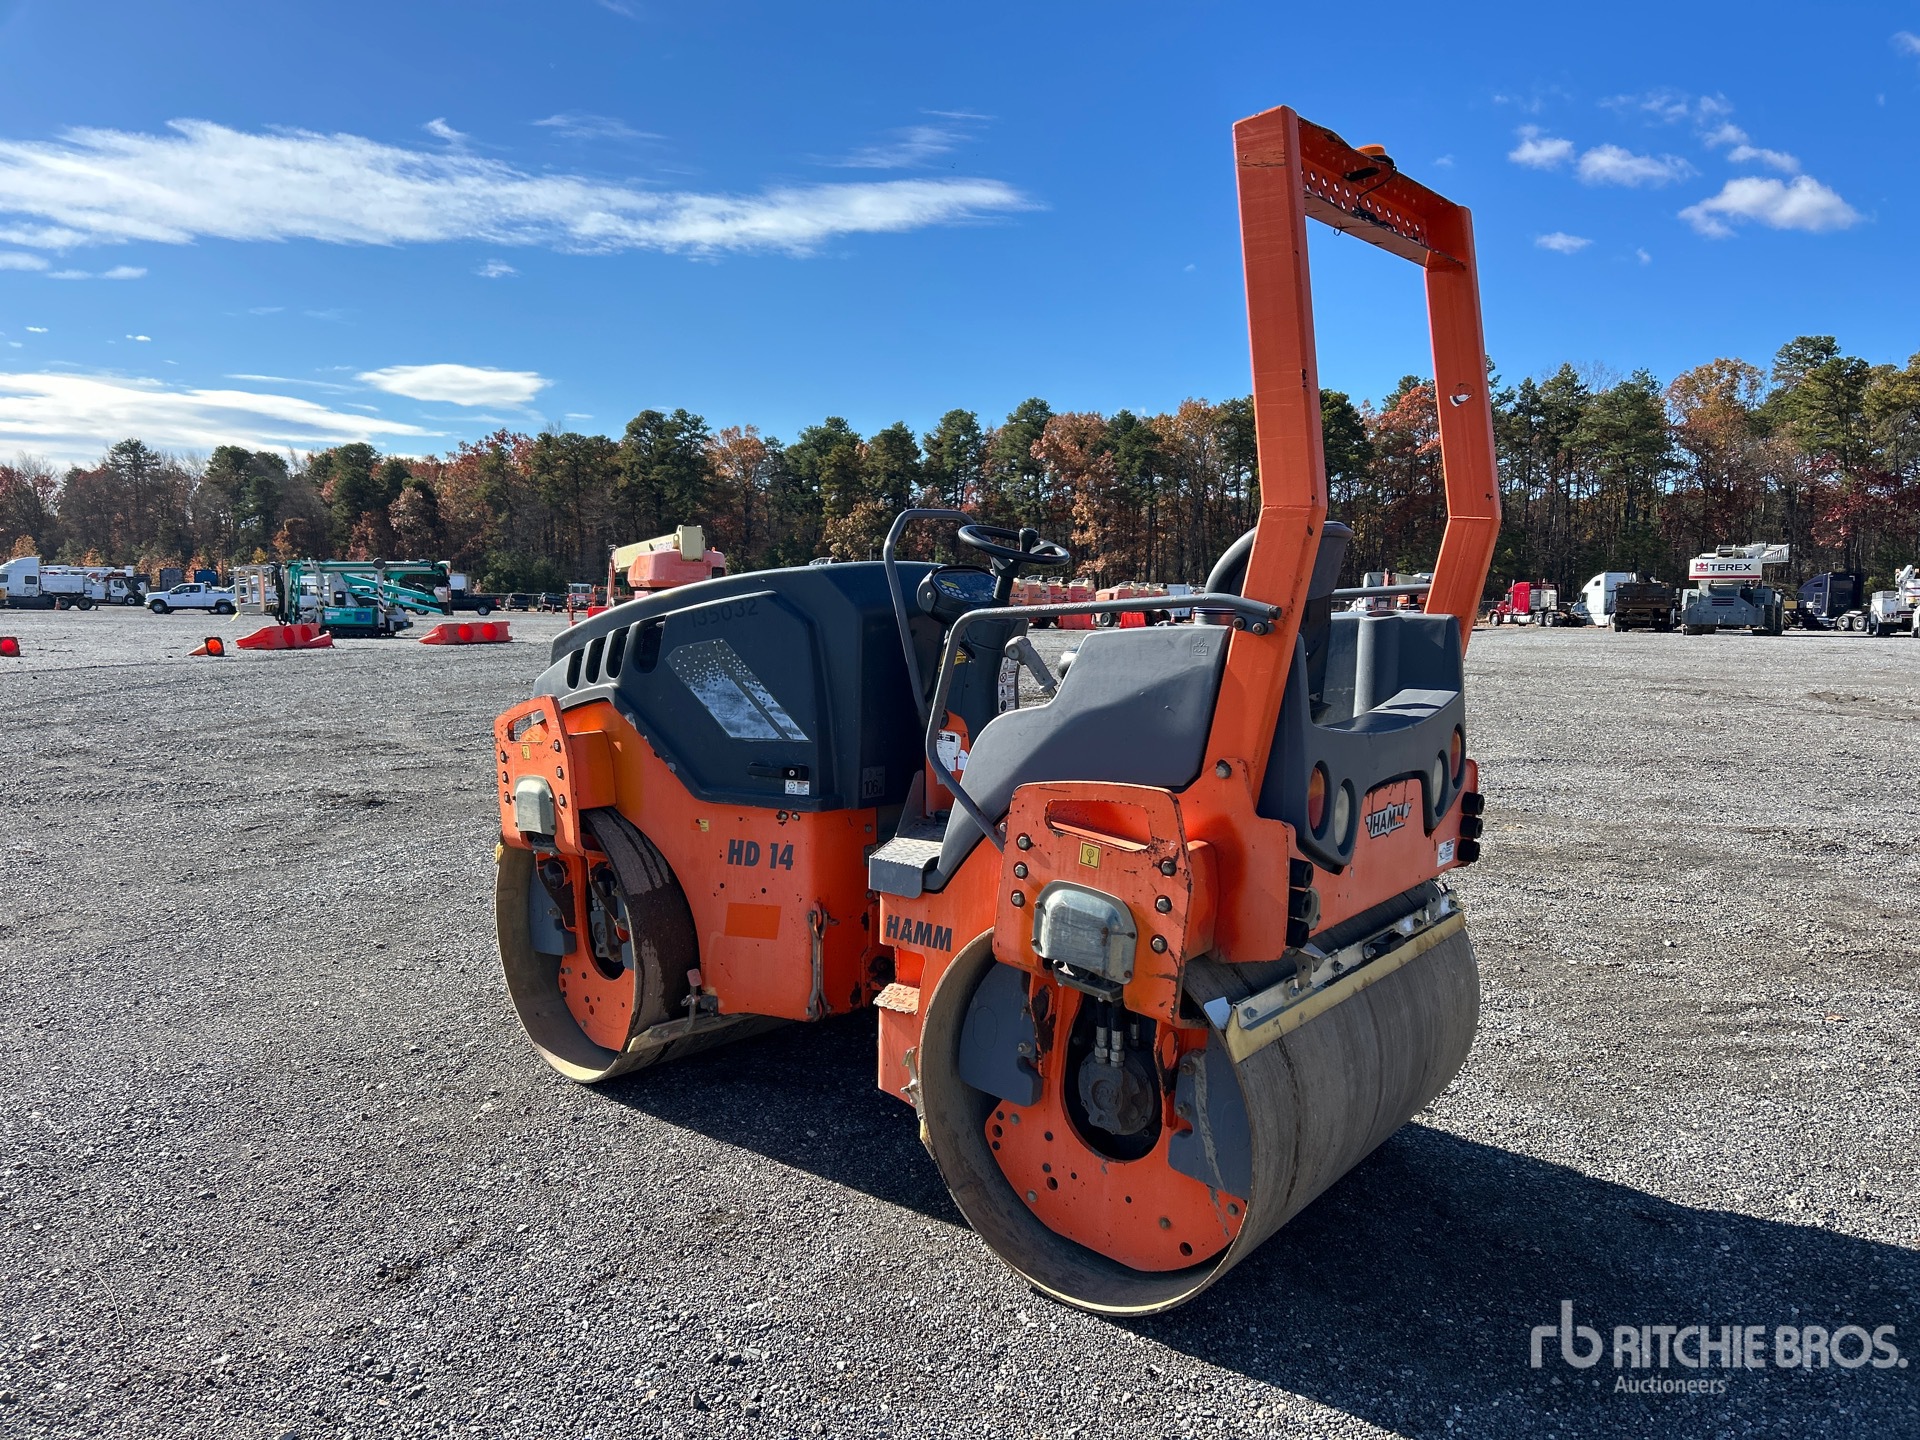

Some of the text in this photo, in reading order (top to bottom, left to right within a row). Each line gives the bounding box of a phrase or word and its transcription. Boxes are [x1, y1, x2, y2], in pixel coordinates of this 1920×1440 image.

[1709, 563, 1752, 571] TEREX
[691, 598, 759, 628] 135032
[727, 839, 794, 870] HD 14
[886, 915, 952, 952] HAMM
